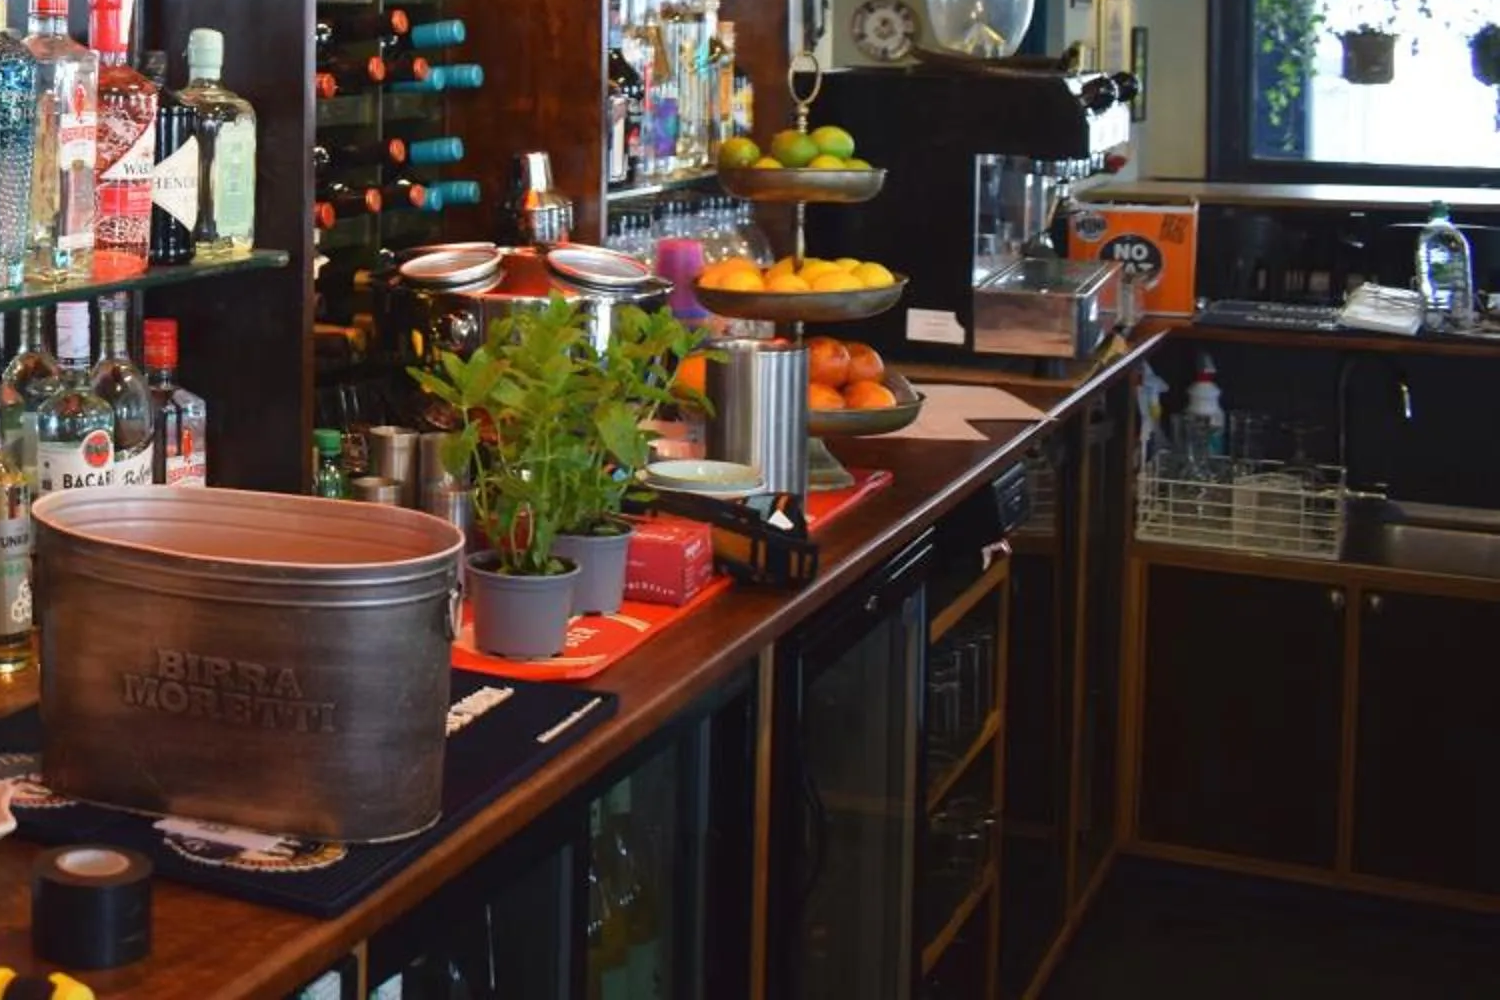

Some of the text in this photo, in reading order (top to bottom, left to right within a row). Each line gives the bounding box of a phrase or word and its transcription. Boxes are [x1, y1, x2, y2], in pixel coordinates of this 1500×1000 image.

[1114, 243, 1149, 261] NO
[156, 648, 303, 699] BIRRA
[123, 672, 338, 733] MORETTI
